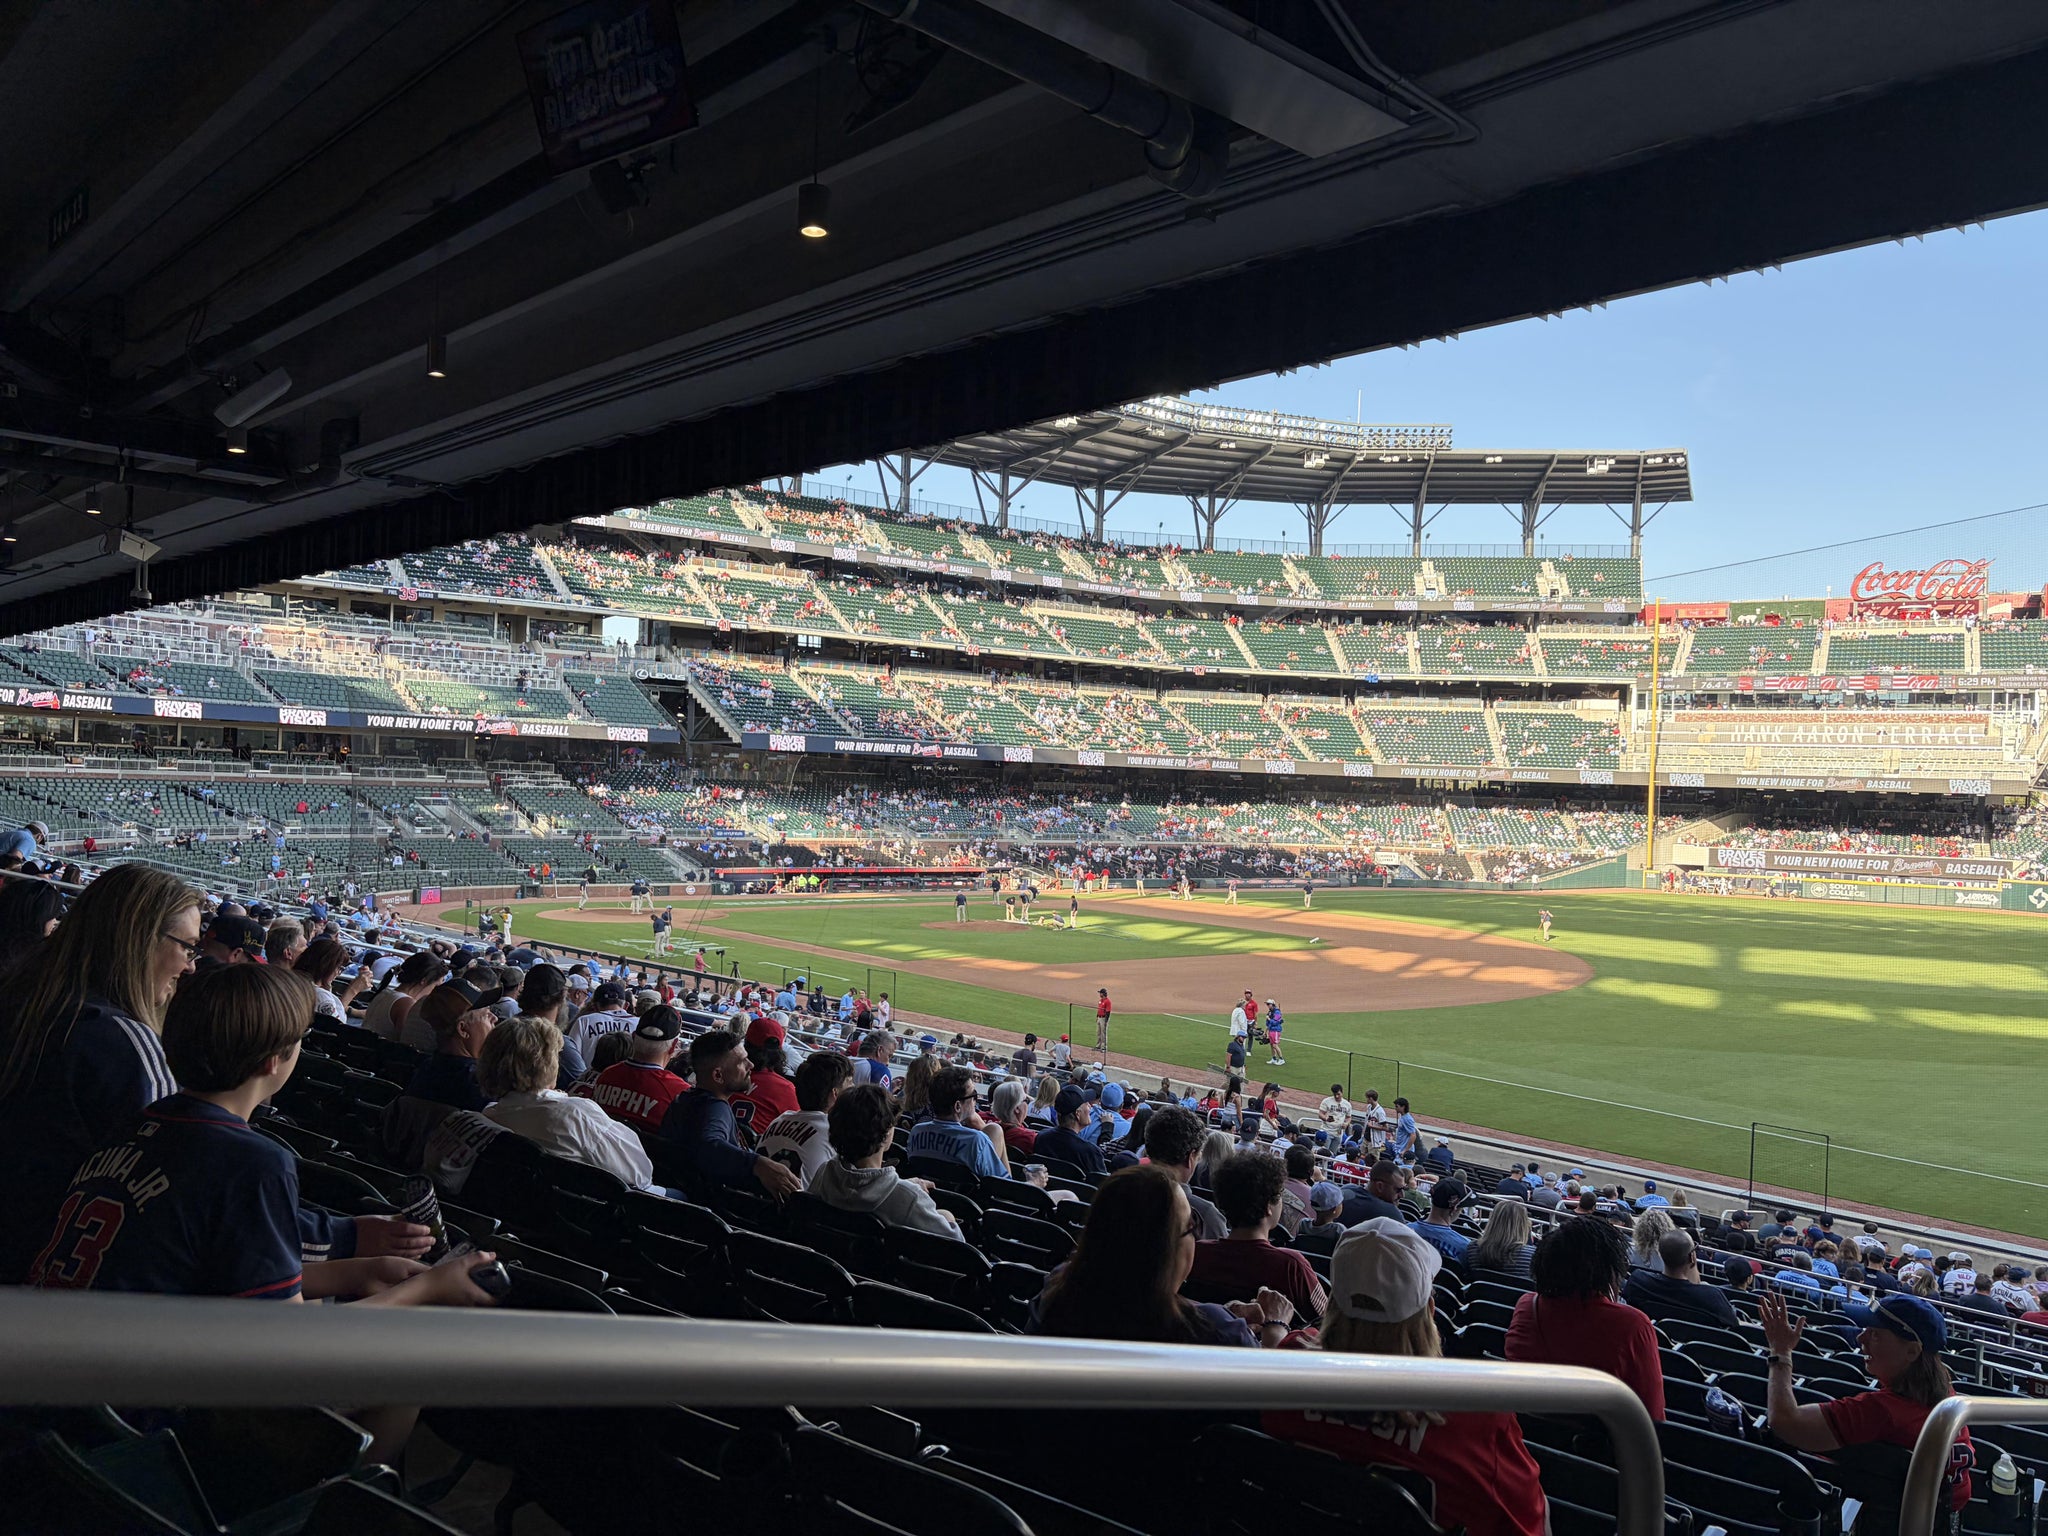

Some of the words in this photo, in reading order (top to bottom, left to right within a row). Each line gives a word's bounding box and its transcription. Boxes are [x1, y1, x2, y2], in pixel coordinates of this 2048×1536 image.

[629, 520, 646, 530] YOUR
[646, 522, 662, 531] NEW
[661, 523, 679, 534] HOME
[679, 525, 693, 535] FOR
[720, 533, 749, 543] BASEBALL
[876, 555, 890, 563] YOUR
[890, 556, 902, 564] NEW
[902, 558, 918, 566] HOME
[918, 560, 927, 568] FOR
[949, 565, 973, 574] BASEBALL
[1850, 557, 1996, 602] Coca-Cola
[399, 587, 418, 601] 35
[717, 618, 731, 632] 41
[966, 644, 980, 656] 44
[649, 672, 686, 681] LEXUS
[1958, 677, 1979, 686] 6:29
[1980, 677, 1996, 686] PM
[63, 694, 113, 711] BASEBALL
[155, 706, 202, 719] VISION
[280, 715, 327, 727] VISION
[367, 715, 393, 727] YOUR
[395, 716, 419, 729] NEW
[420, 718, 452, 731] HOME
[453, 720, 474, 732] FOR
[521, 723, 570, 736] BASEBALL
[607, 732, 648, 743] VISION
[769, 734, 806, 744] BRAVES
[1731, 725, 1785, 743] HANK
[1793, 725, 1864, 744] AARON
[1876, 726, 1979, 745] TERRACE
[769, 741, 806, 752] VISION
[834, 740, 855, 751] YOUR
[855, 741, 874, 752] NEW
[874, 742, 897, 753] HOME
[896, 743, 911, 754] FOR
[944, 745, 978, 757] BASEBALL
[1004, 746, 1033, 756] BRAVES
[1004, 753, 1033, 763] VISION
[1077, 751, 1105, 760] BRAVES
[1077, 757, 1105, 766] VISION
[1127, 756, 1143, 765] YOUR
[1142, 756, 1157, 766] NEW
[1157, 757, 1174, 767] HOME
[1174, 758, 1187, 767] FOR
[1211, 759, 1239, 769] BASEBALL
[1265, 761, 1296, 769] BRAVES
[1344, 763, 1374, 771] BRAVES
[1344, 769, 1374, 777] VISION
[1400, 767, 1420, 776] YOUR
[1420, 768, 1439, 776] NEW
[1438, 768, 1461, 777] HOME
[1461, 769, 1477, 778] FOR
[1512, 770, 1550, 780] BASEBALL
[1580, 771, 1614, 779] BRAVES
[1669, 773, 1705, 782] BRAVES
[1580, 777, 1614, 785] VISION
[1669, 779, 1705, 787] VISION
[1736, 776, 1759, 786] YOUR
[1759, 777, 1779, 786] NEW
[1779, 778, 1805, 787] HOME
[1806, 778, 1824, 788] FOR
[1866, 780, 1912, 790] BASEBALL
[1949, 779, 1992, 787] BRAVES
[1949, 785, 1992, 794] VISION
[1717, 850, 1766, 859] BRAVES
[1717, 857, 1766, 868] VISION
[1773, 855, 1803, 866] YOUR
[1803, 856, 1829, 868] NEW
[1831, 857, 1866, 869] HOME
[1866, 859, 1889, 871] FOR
[1892, 858, 1936, 873] Braves
[1945, 863, 2005, 876] BASEBALL
[1829, 889, 1866, 898] COLLEGE
[592, 1083, 659, 1118] MURPHY
[911, 1131, 966, 1157] MURPHY
[67, 1141, 145, 1193] ACUÑA
[26, 1191, 126, 1288] 13
[1953, 1281, 1976, 1296] 27
